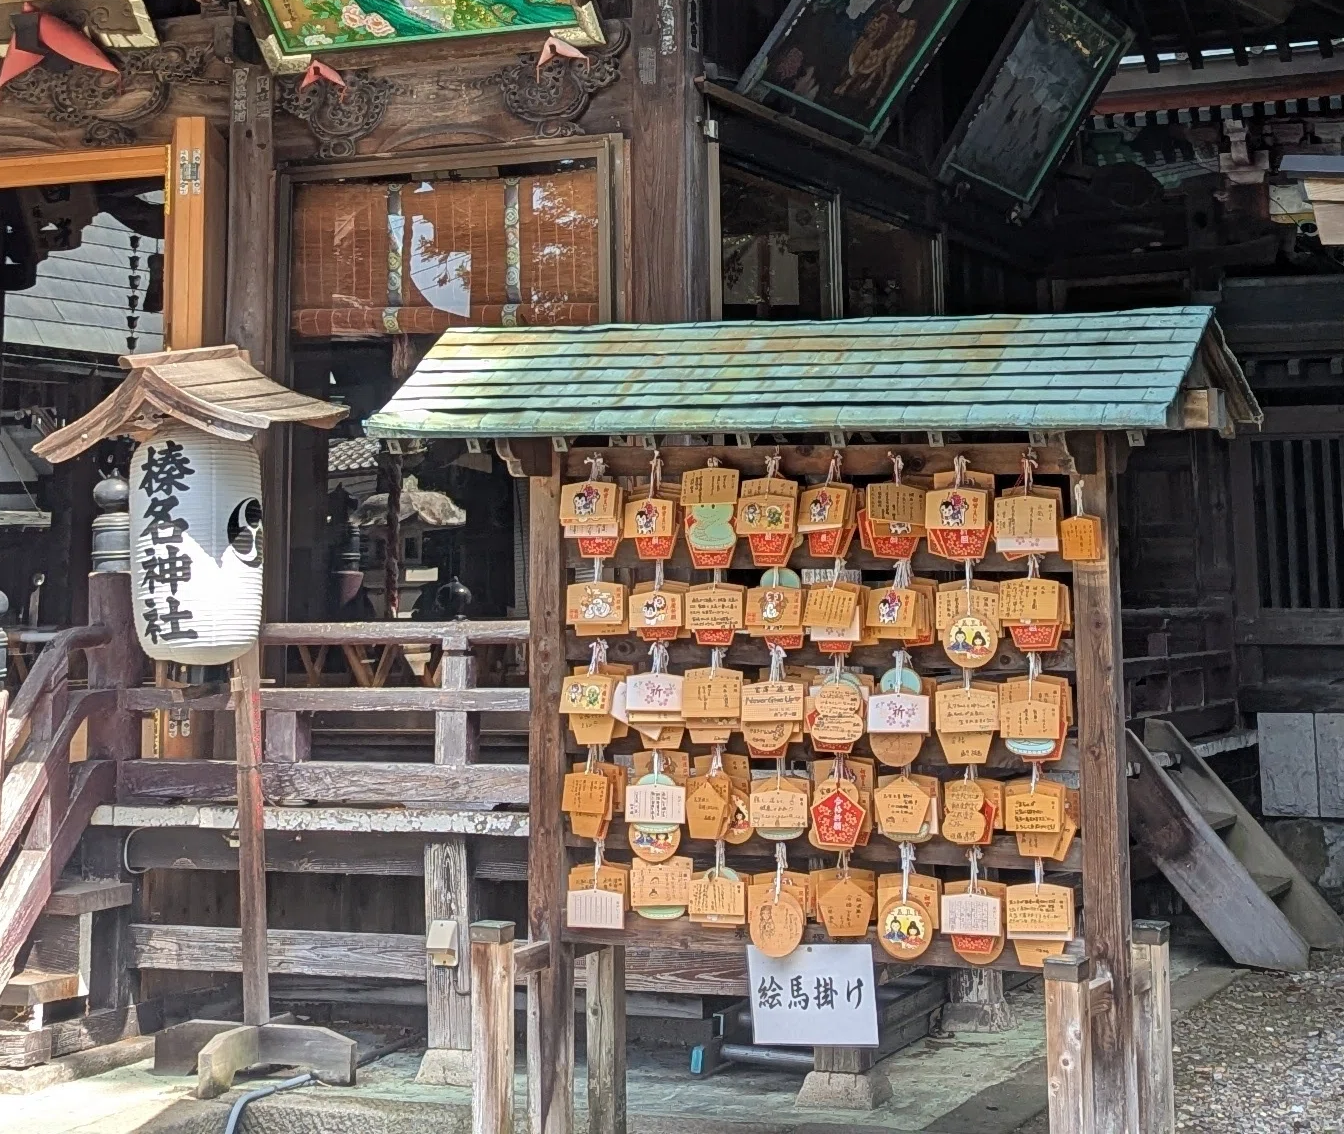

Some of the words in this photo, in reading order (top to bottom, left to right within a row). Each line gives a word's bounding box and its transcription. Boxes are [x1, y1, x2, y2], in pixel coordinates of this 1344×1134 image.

[139, 440, 199, 645] 榛名神社
[650, 684, 664, 698] 祈
[892, 704, 905, 717] 祈
[757, 974, 865, 1011] 絵馬掛け
